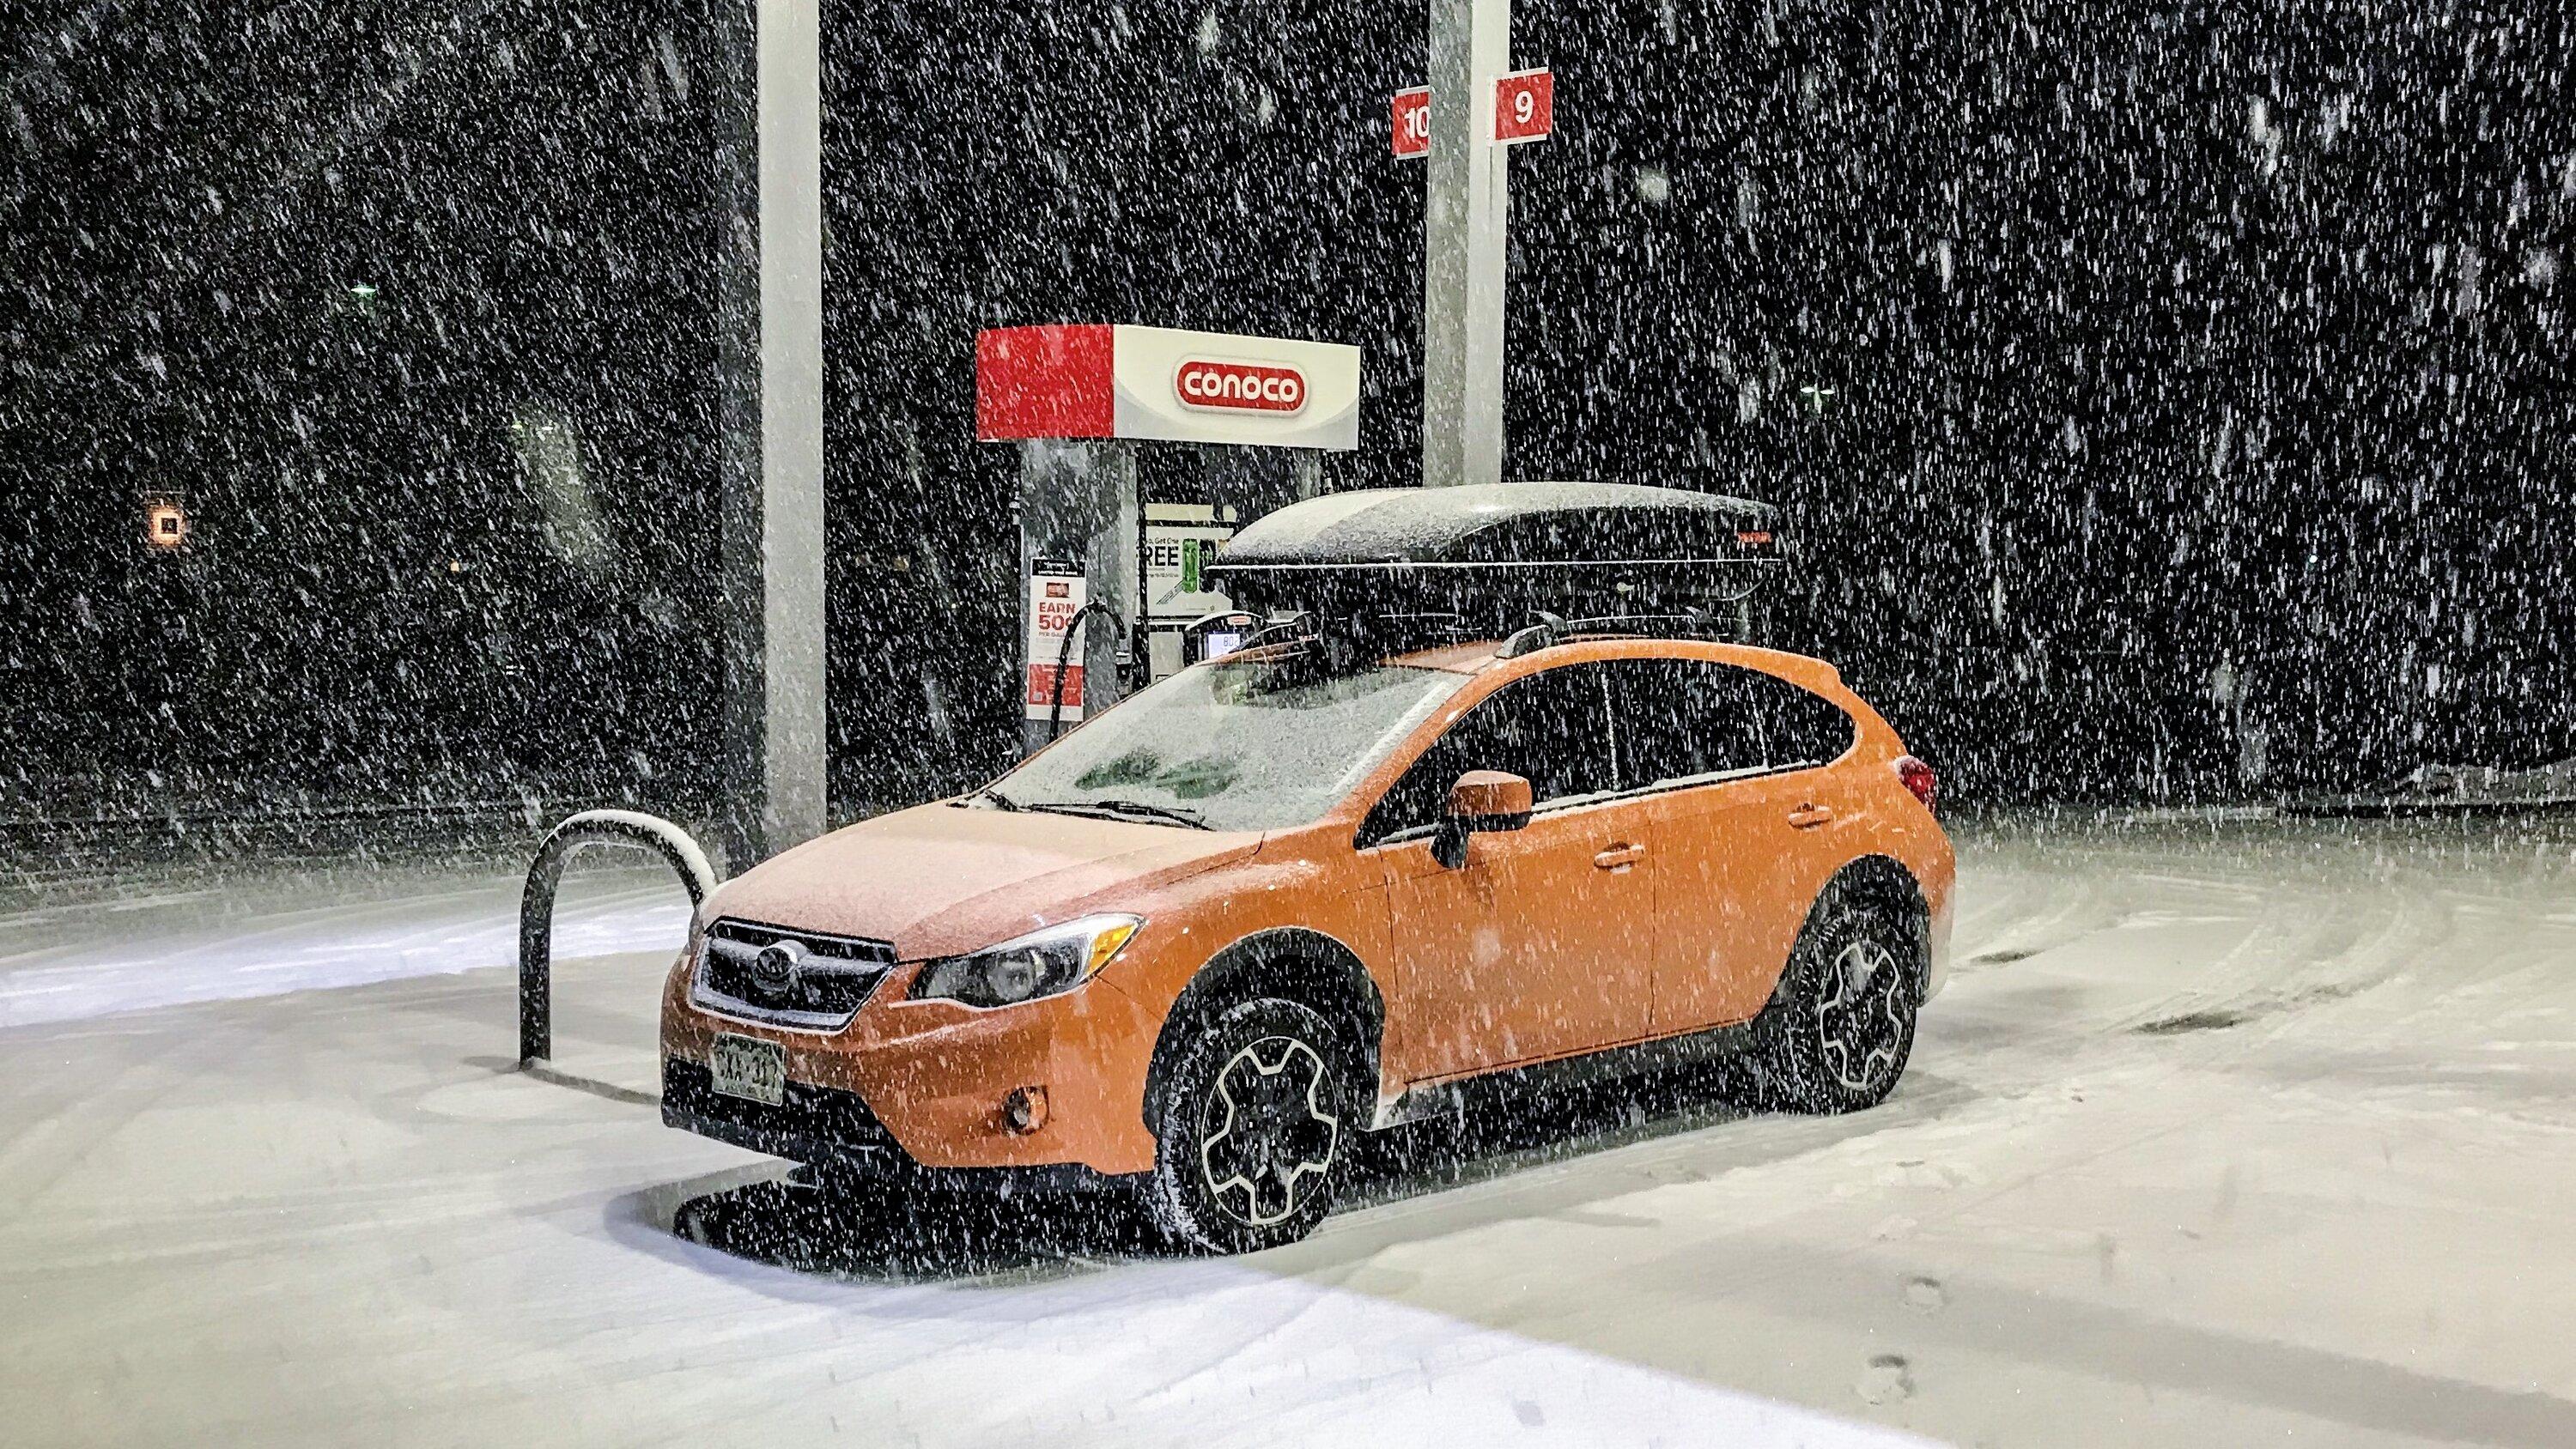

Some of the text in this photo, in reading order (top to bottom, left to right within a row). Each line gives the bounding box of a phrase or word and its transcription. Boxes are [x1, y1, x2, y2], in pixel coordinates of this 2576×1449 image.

[1515, 90, 1534, 124] 9
[1404, 106, 1431, 139] 10
[1137, 546, 1179, 566] REE
[1039, 602, 1076, 614] EARN
